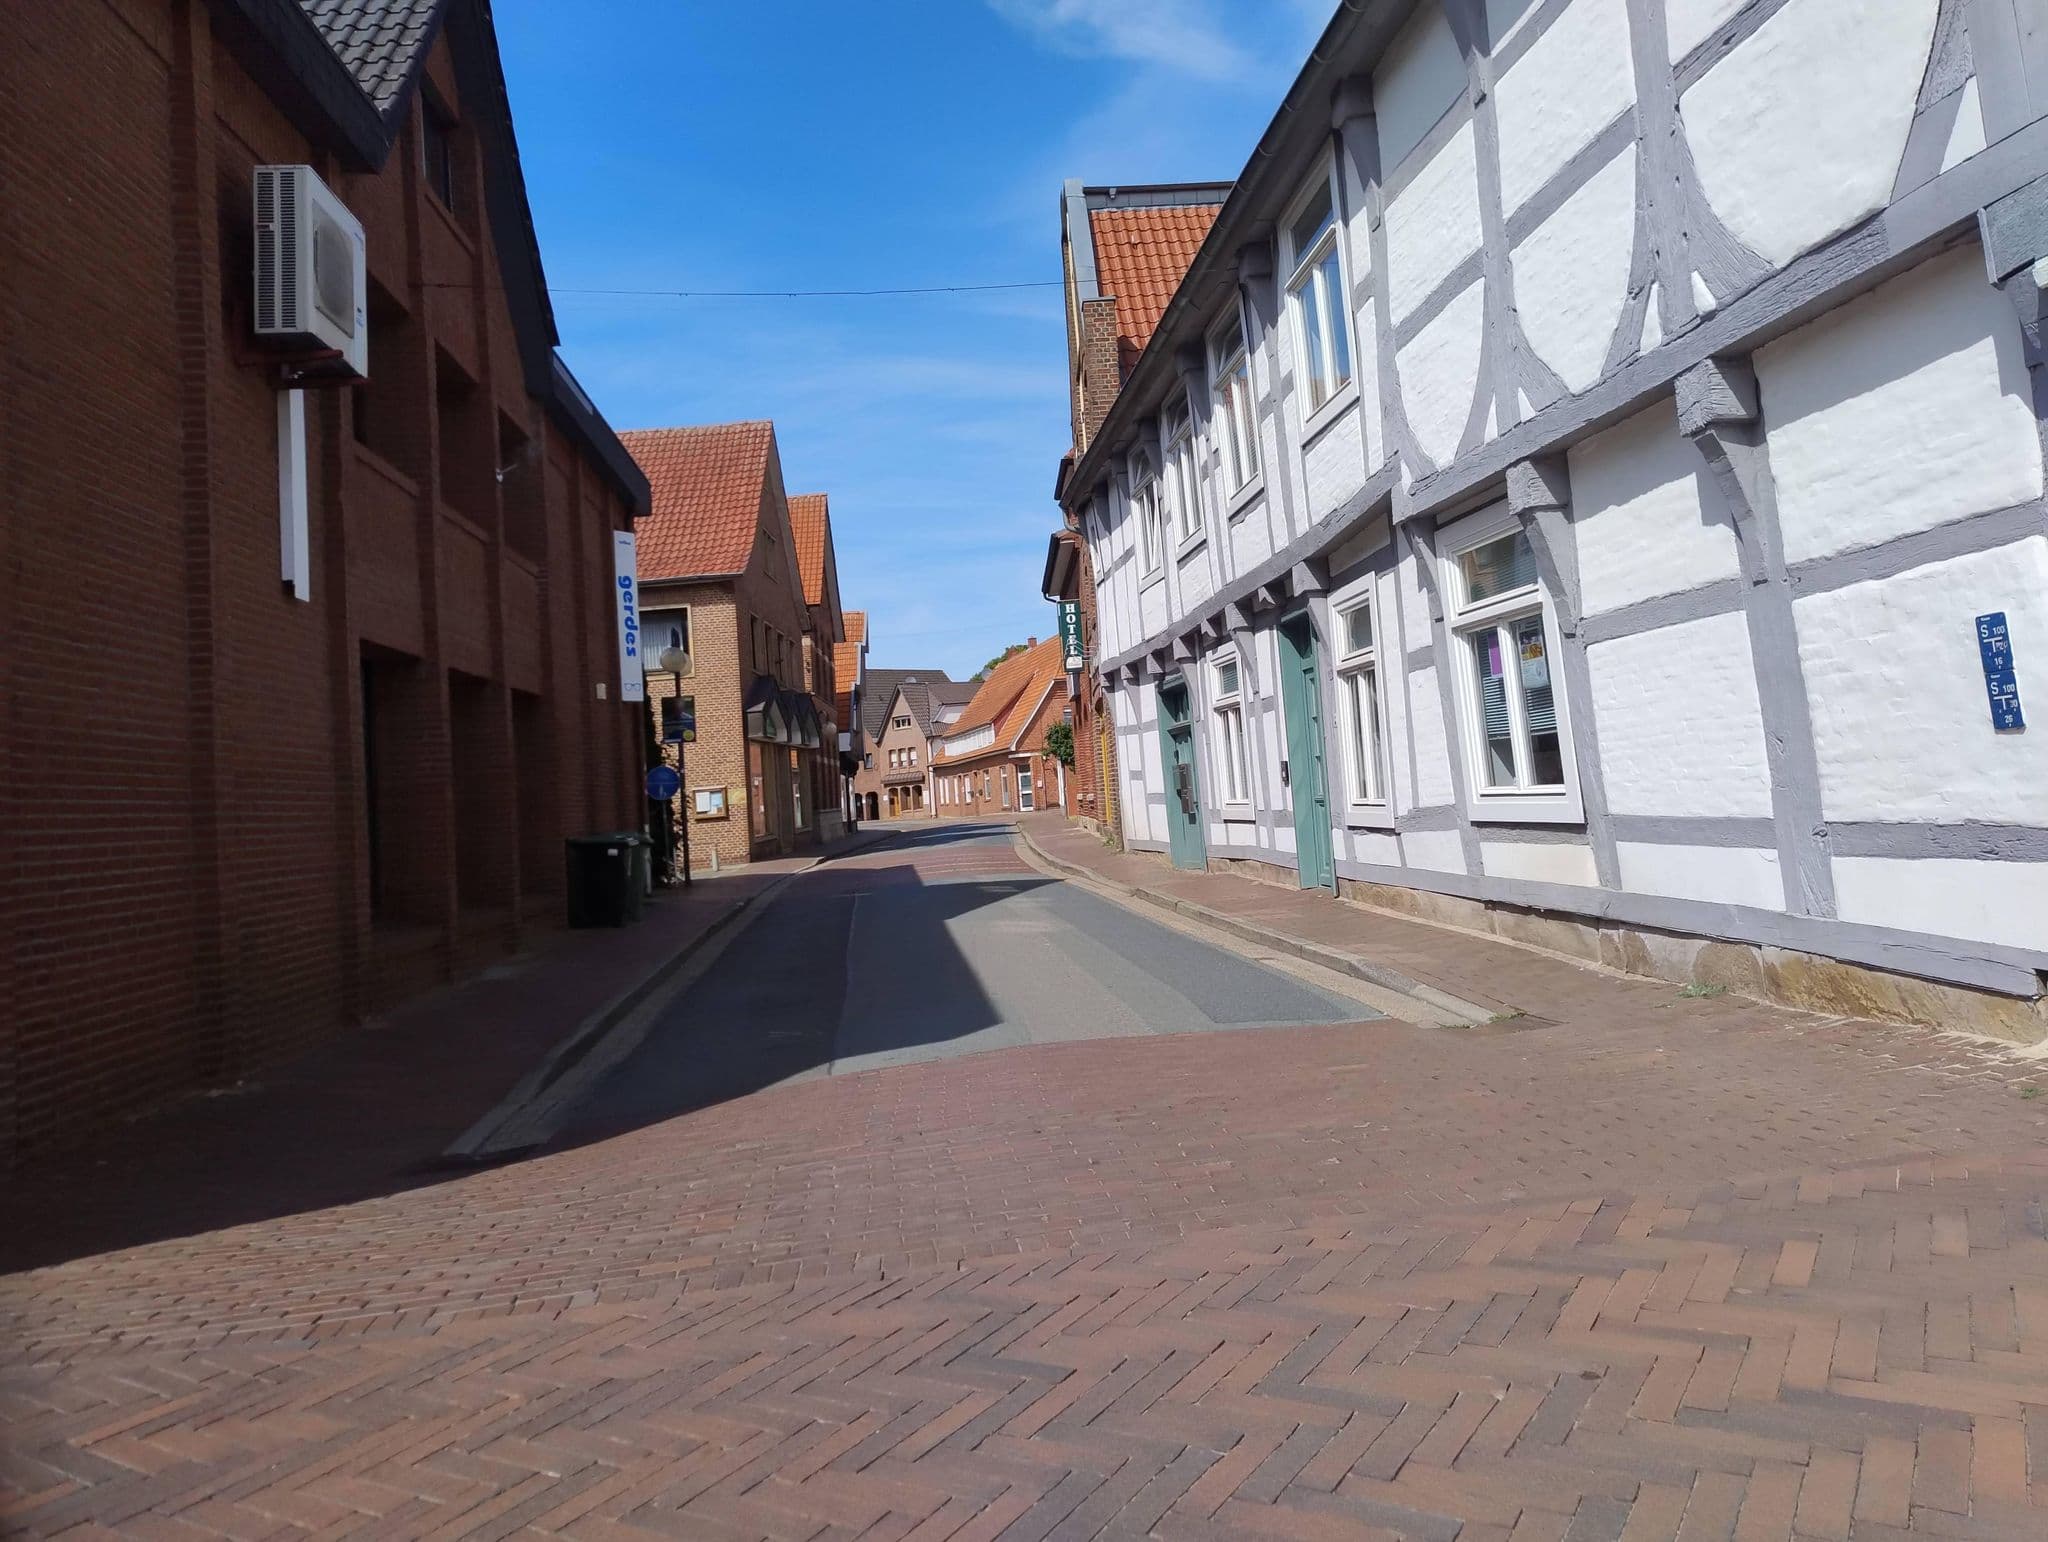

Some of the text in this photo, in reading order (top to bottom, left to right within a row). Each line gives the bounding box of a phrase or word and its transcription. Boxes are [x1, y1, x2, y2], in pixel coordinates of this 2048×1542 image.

[618, 576, 638, 657] gerdes
[1065, 603, 1078, 655] HOTEL
[1980, 625, 2006, 637] S 100
[1990, 682, 2016, 694] S 100
